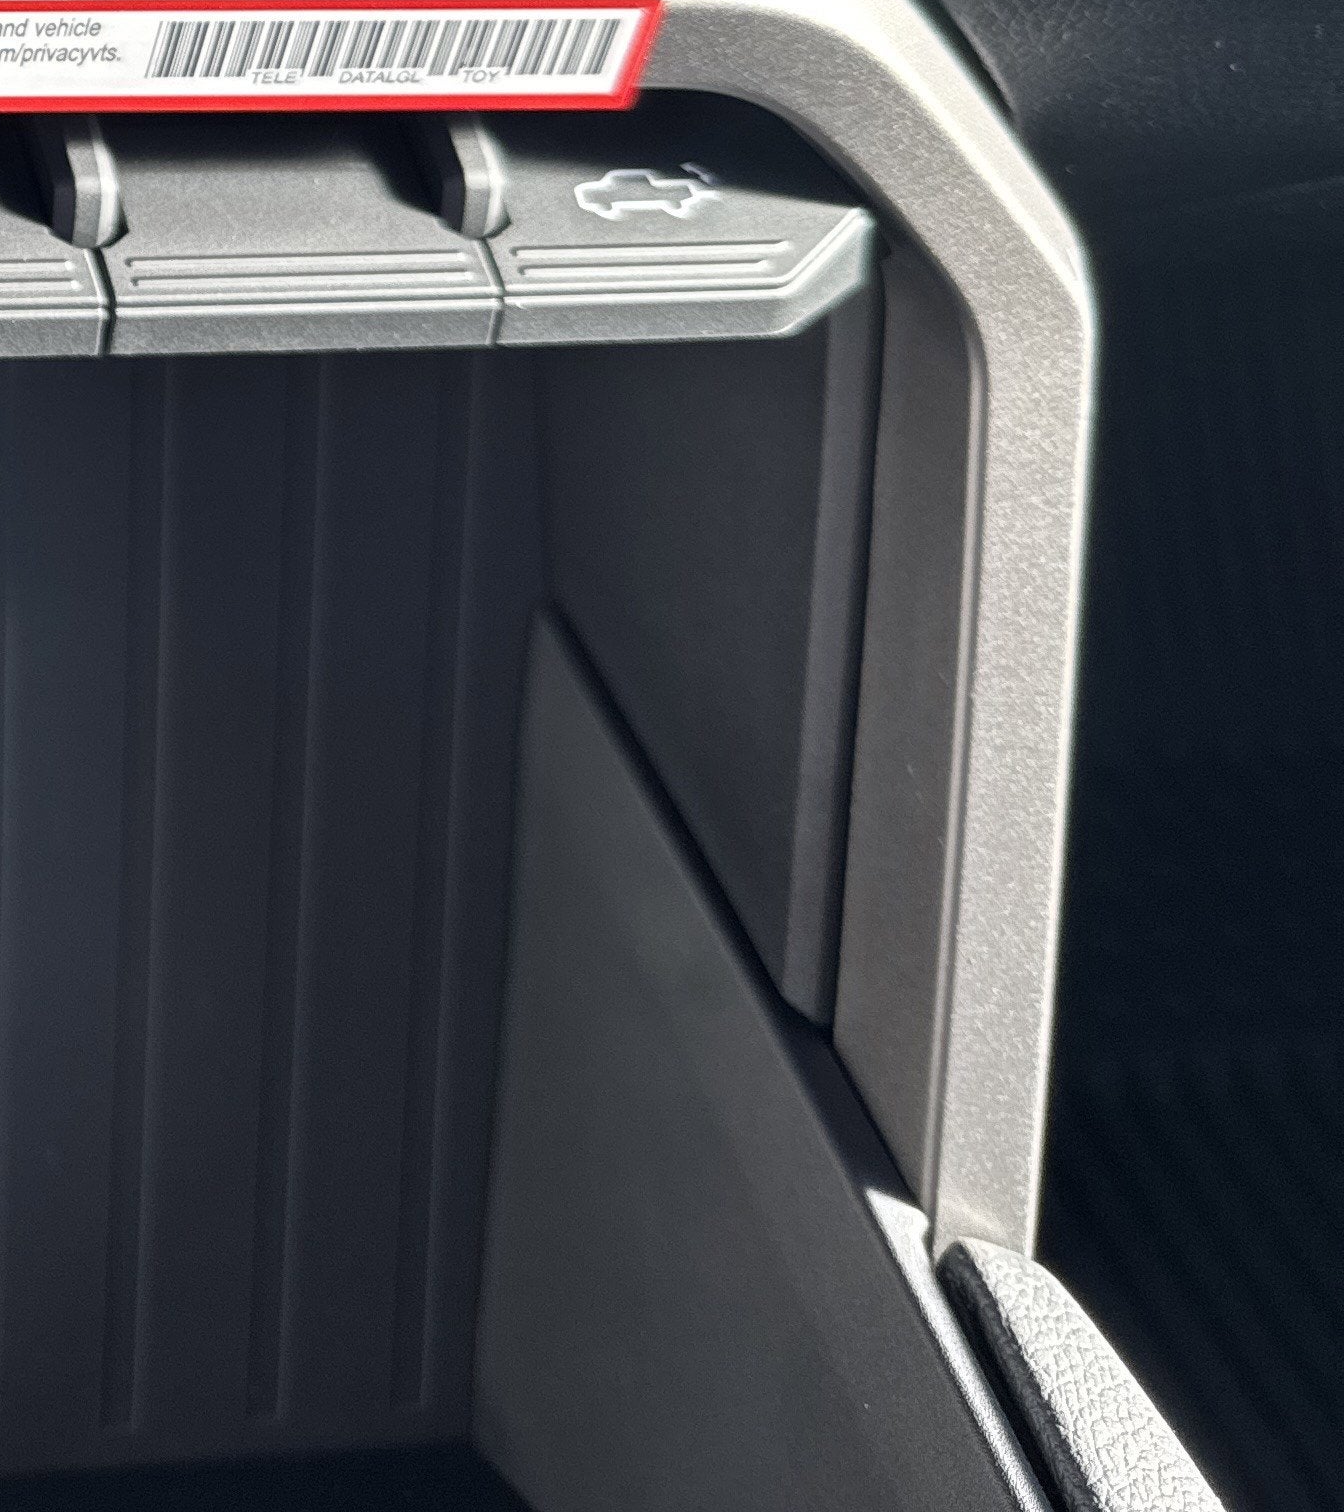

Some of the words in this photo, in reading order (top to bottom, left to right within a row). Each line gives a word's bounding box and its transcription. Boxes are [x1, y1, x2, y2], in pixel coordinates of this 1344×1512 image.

[35, 18, 102, 38] vehicle
[251, 70, 298, 84] TELE
[462, 69, 502, 83] TOY
